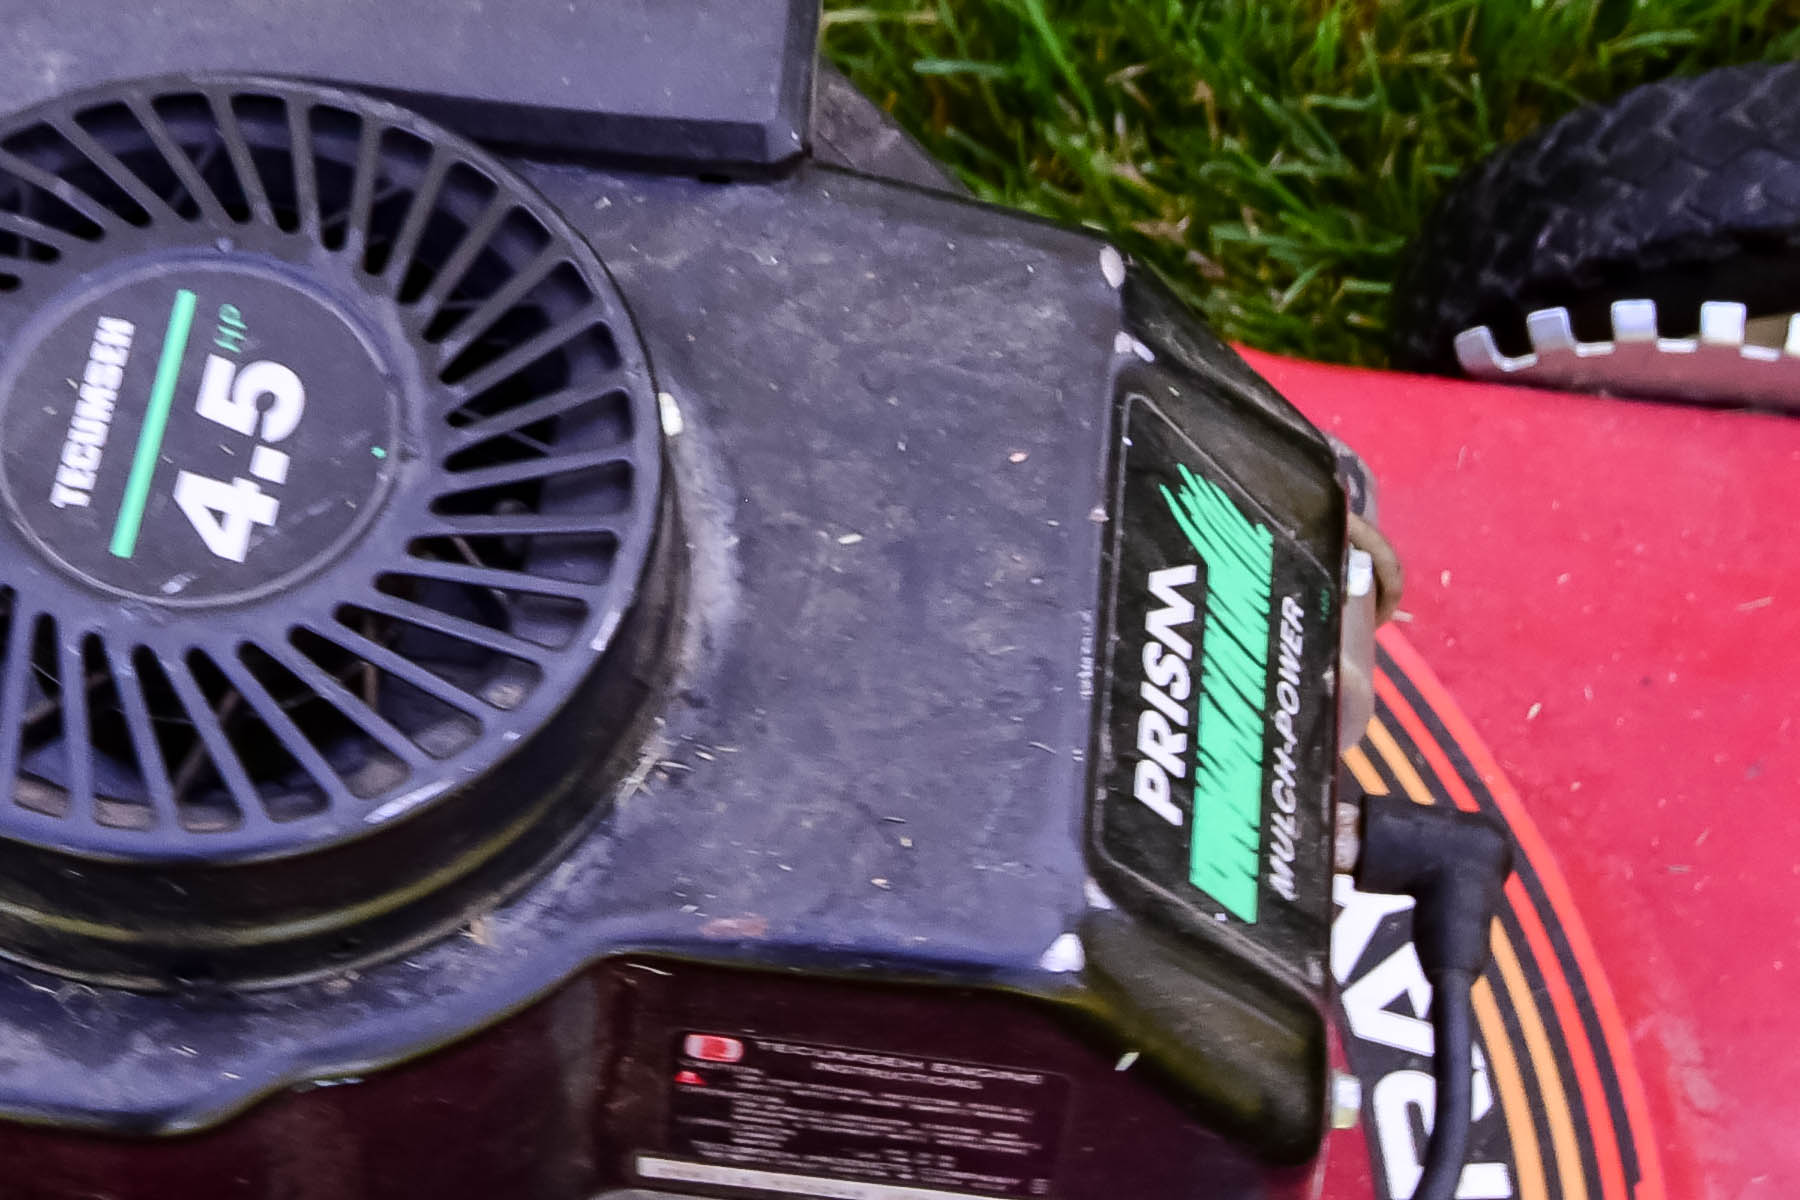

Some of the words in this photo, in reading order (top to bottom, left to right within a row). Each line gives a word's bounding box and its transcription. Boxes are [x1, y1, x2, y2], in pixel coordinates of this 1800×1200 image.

[49, 315, 136, 509] TECUMSEH
[214, 302, 248, 353] HP
[172, 353, 306, 564] 4.5
[1133, 564, 1198, 827] PRISM
[1268, 596, 1306, 902] MULCH-POWER
